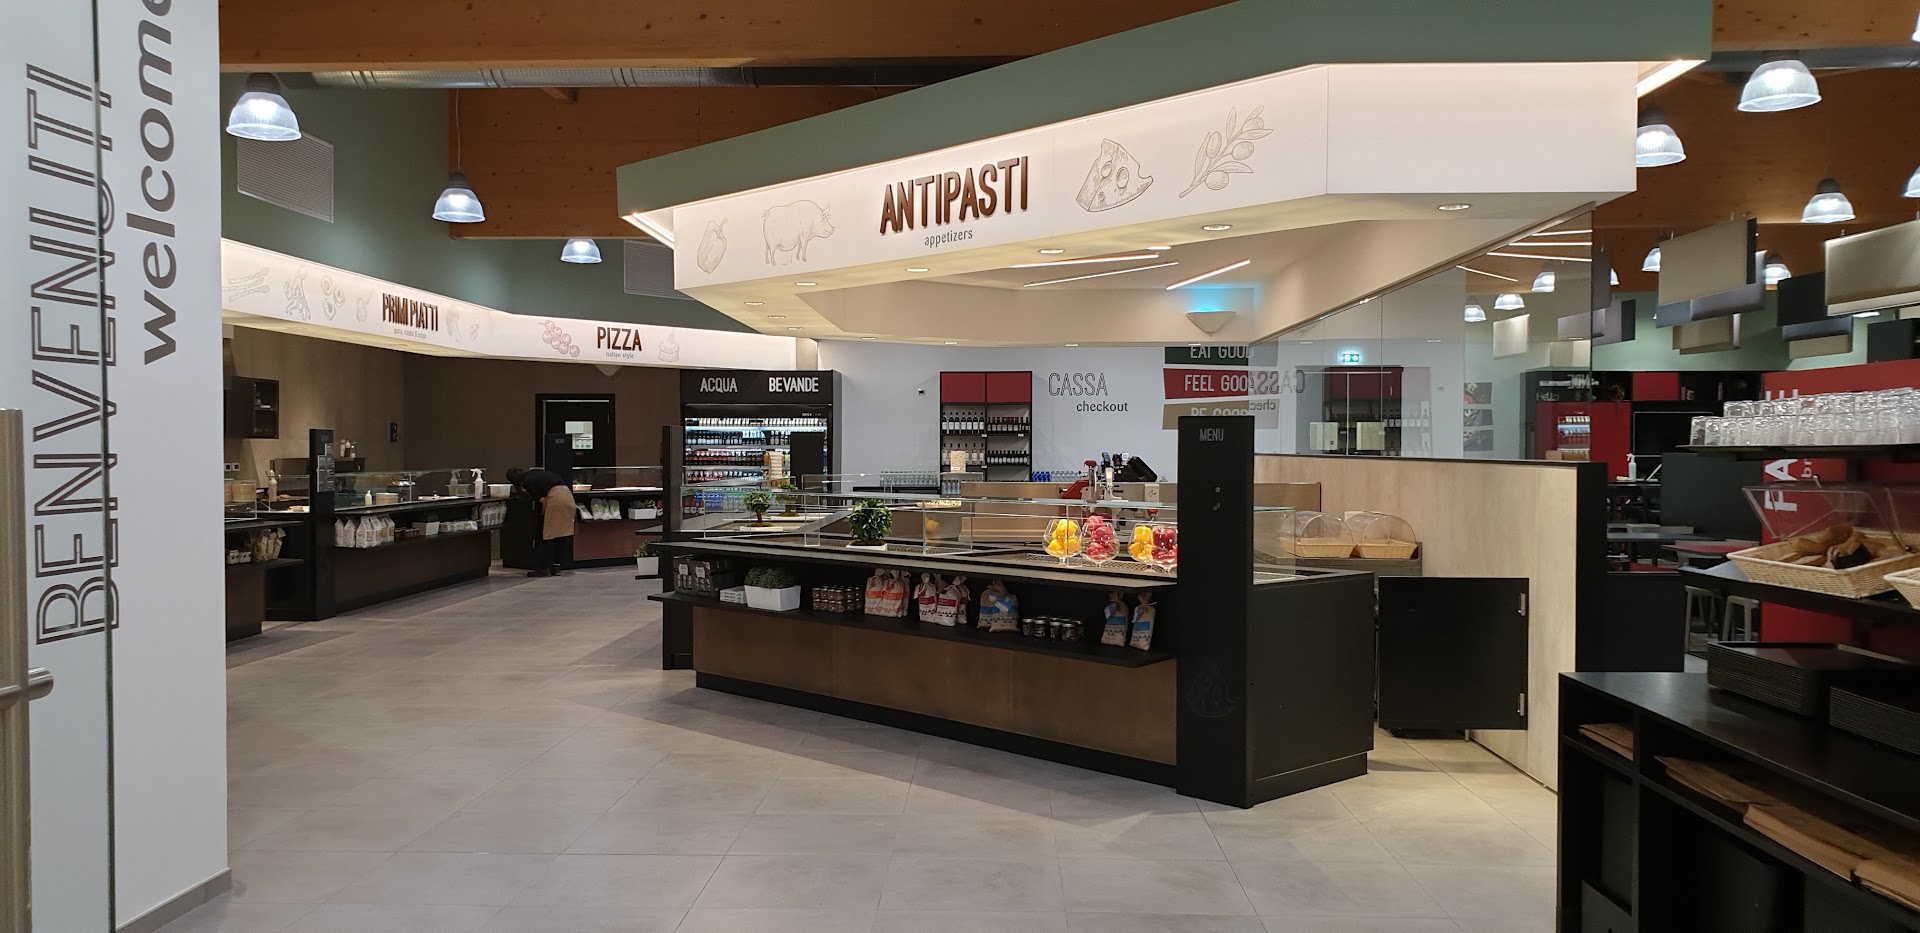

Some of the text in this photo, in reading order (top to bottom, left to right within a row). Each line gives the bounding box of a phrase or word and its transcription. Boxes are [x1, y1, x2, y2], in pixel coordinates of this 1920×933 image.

[879, 155, 1029, 234] ANTIPASTI
[924, 229, 973, 248] appetizers
[382, 292, 439, 332] PRIMI PIATTI
[597, 326, 642, 352] PIZZA
[26, 63, 119, 645] BENVENUTI
[700, 377, 819, 393] ACQUA BEVANDE
[1048, 372, 1108, 397] CASSA
[1184, 374, 1252, 392] FEEL GOO
[1076, 400, 1129, 412] checkout
[1199, 428, 1224, 442] MENU
